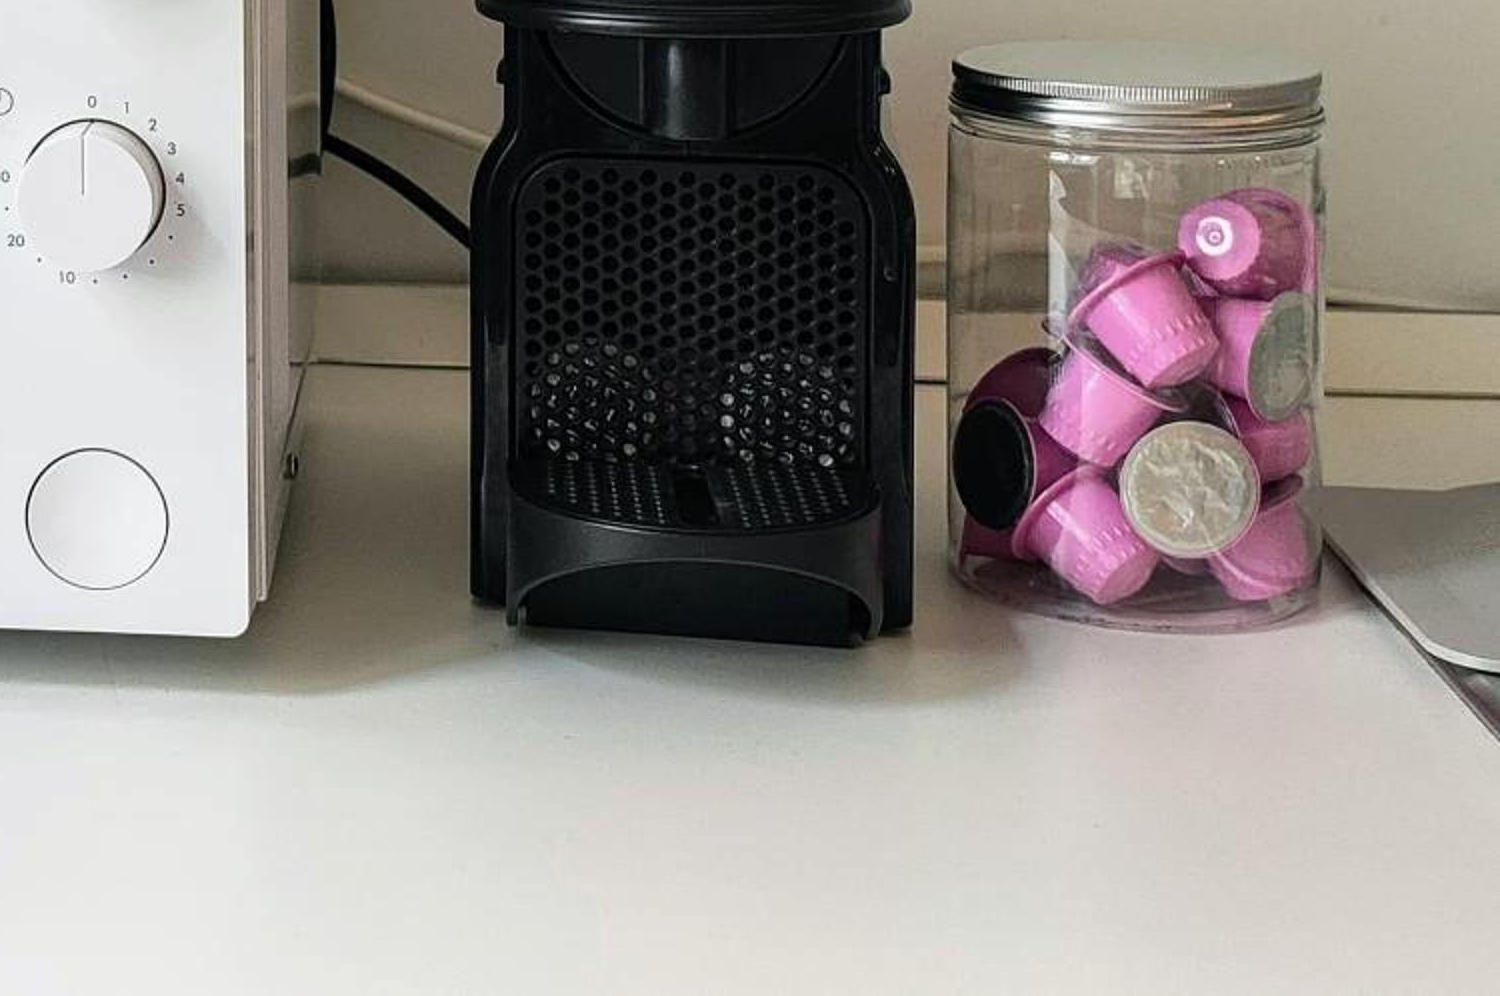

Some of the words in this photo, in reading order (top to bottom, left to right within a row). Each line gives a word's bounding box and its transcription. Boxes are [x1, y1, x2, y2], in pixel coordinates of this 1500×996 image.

[87, 95, 98, 109] 0
[148, 118, 157, 132] 2
[167, 141, 177, 156] 3
[175, 172, 185, 185] 4
[176, 203, 186, 217] 5
[7, 233, 26, 248] 20
[59, 270, 77, 285] 10
